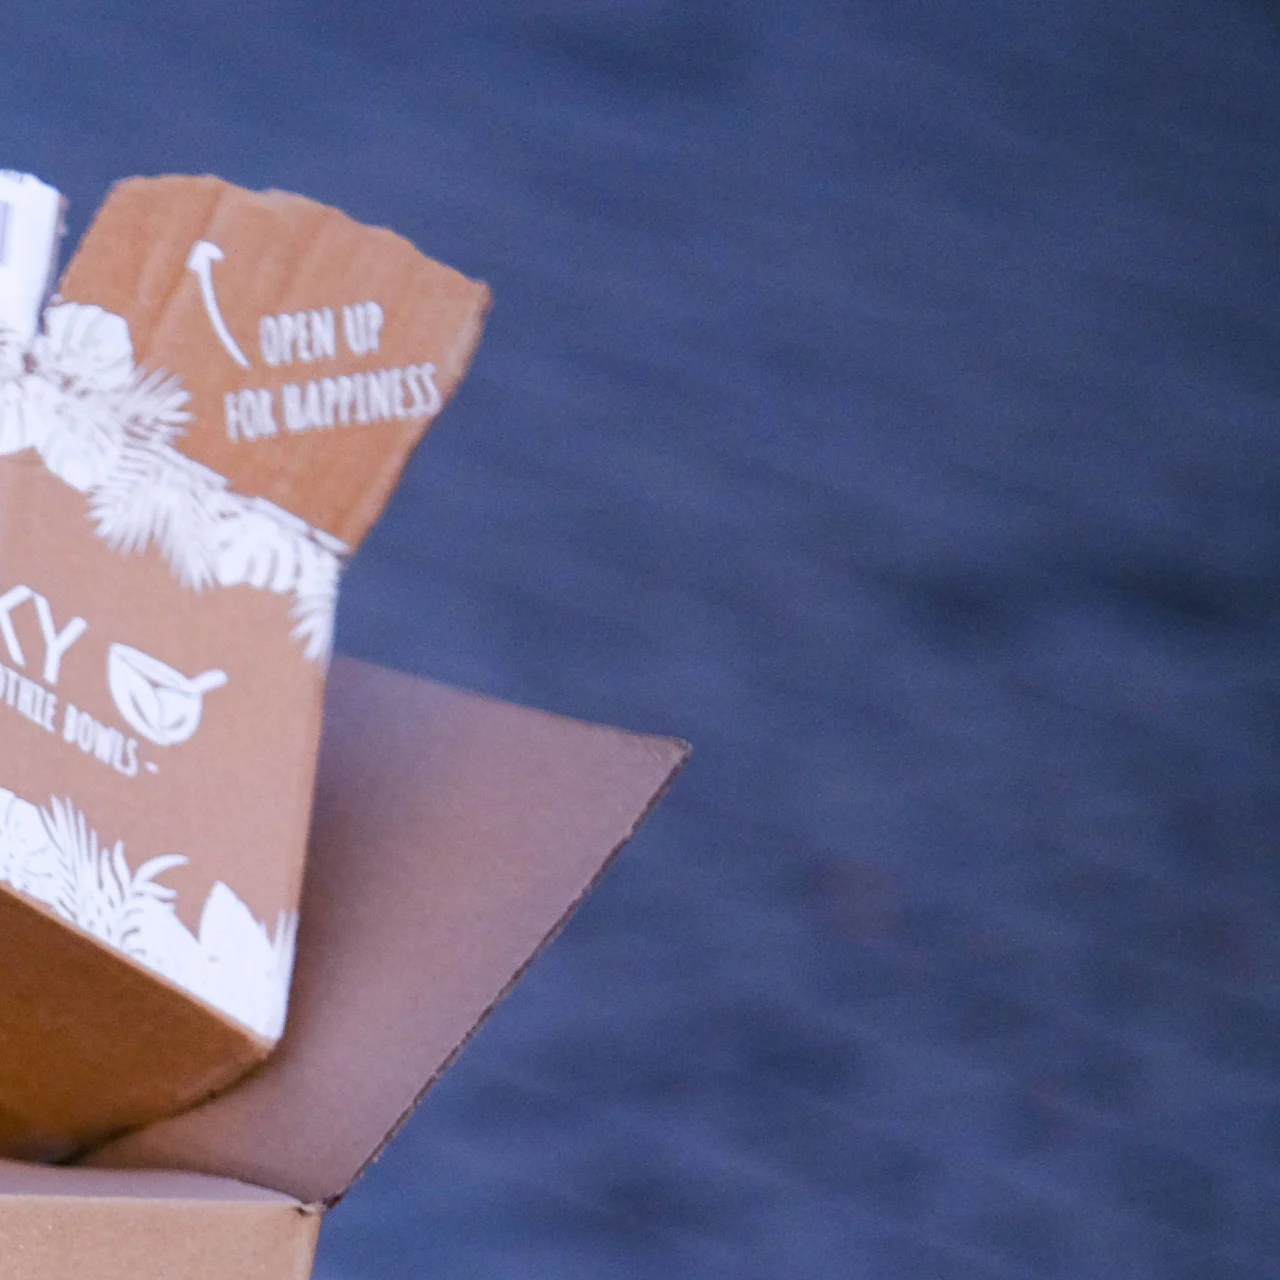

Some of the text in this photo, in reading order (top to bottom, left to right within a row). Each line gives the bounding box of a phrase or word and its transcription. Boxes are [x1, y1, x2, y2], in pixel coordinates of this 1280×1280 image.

[260, 301, 384, 367] OPEN UP
[224, 362, 441, 443] FOR HAPPINESS
[64, 703, 138, 777] BOWLS
